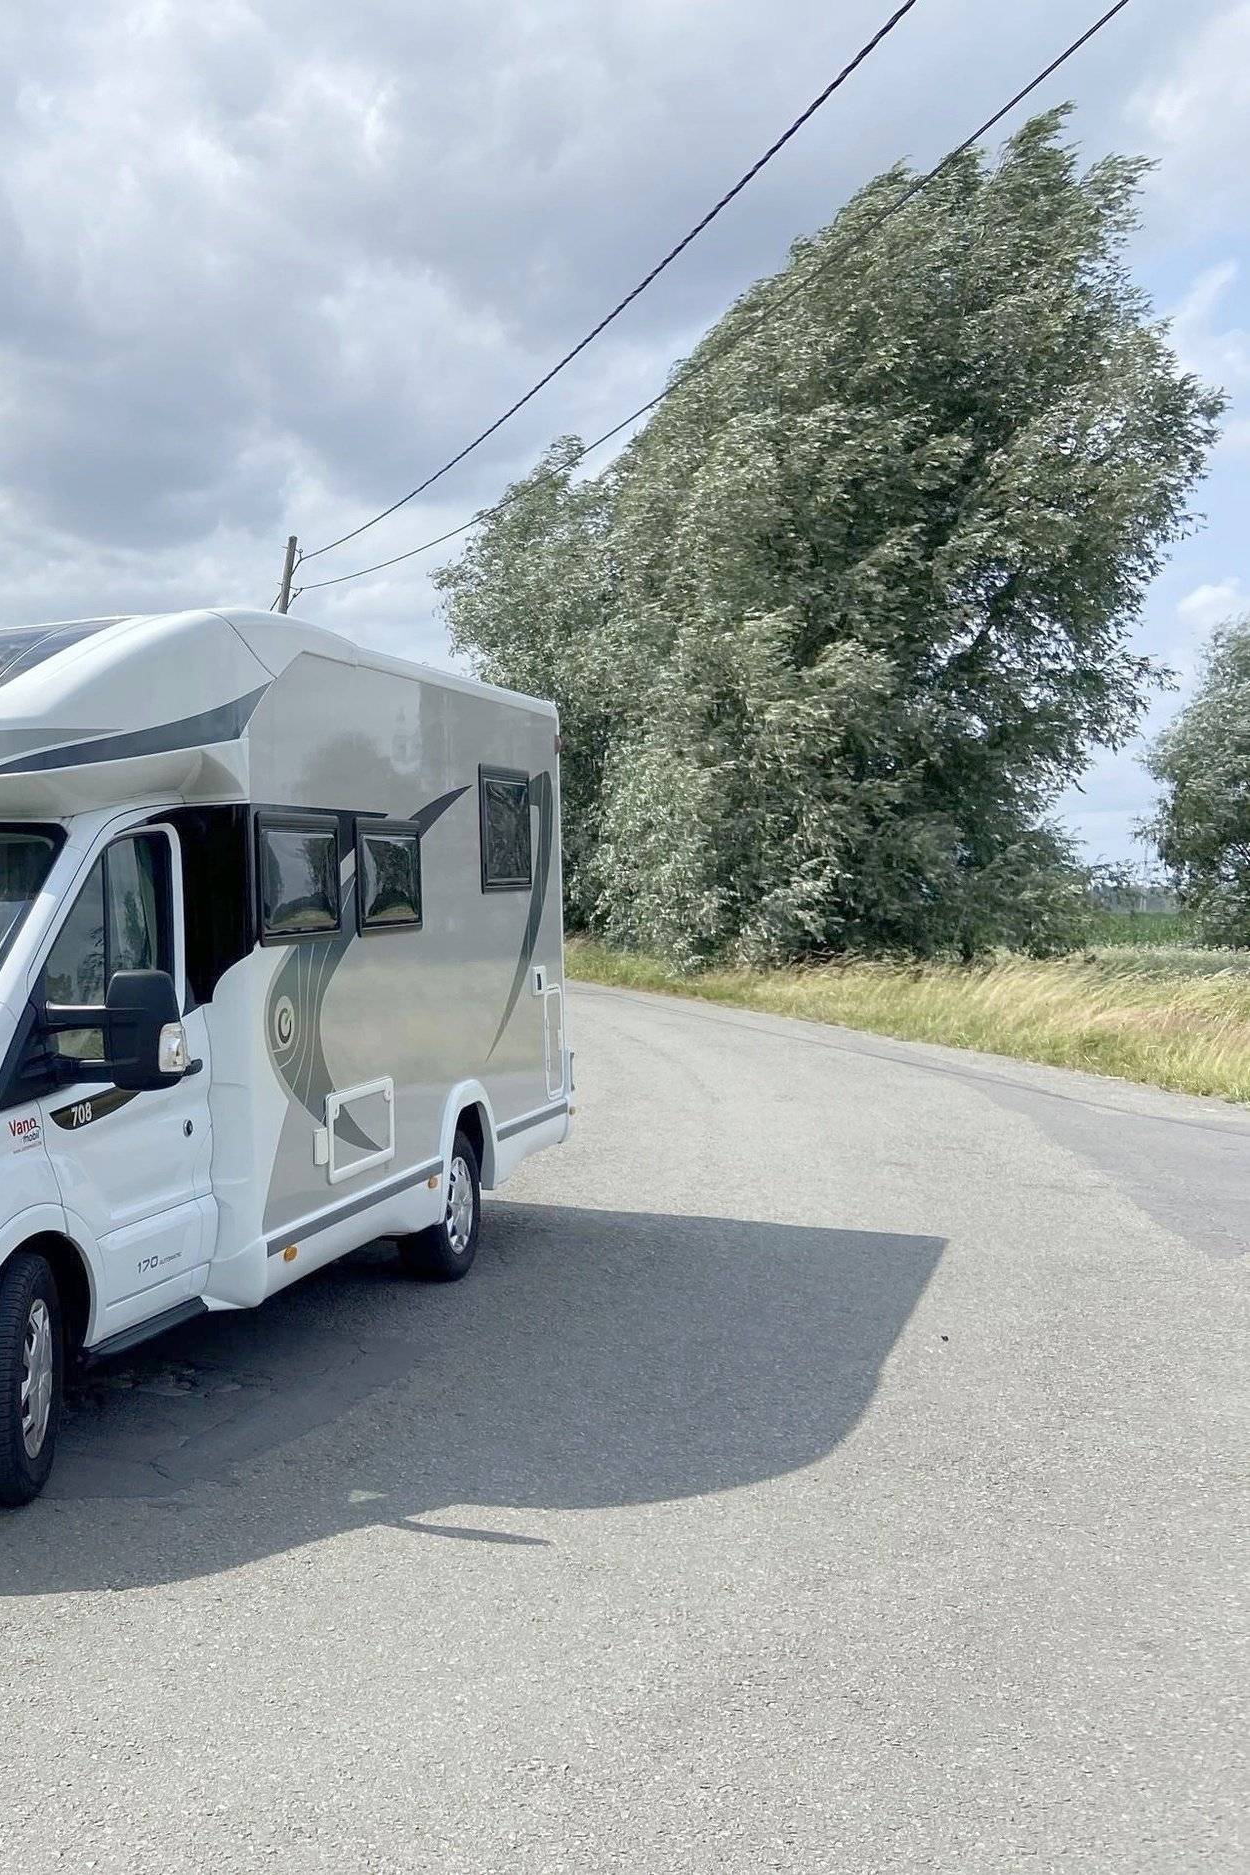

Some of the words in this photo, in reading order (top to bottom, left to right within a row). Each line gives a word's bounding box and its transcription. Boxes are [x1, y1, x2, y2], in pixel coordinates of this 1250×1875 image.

[71, 1101, 92, 1127] 708
[9, 1117, 37, 1137] Vano
[137, 1255, 159, 1273] 170
